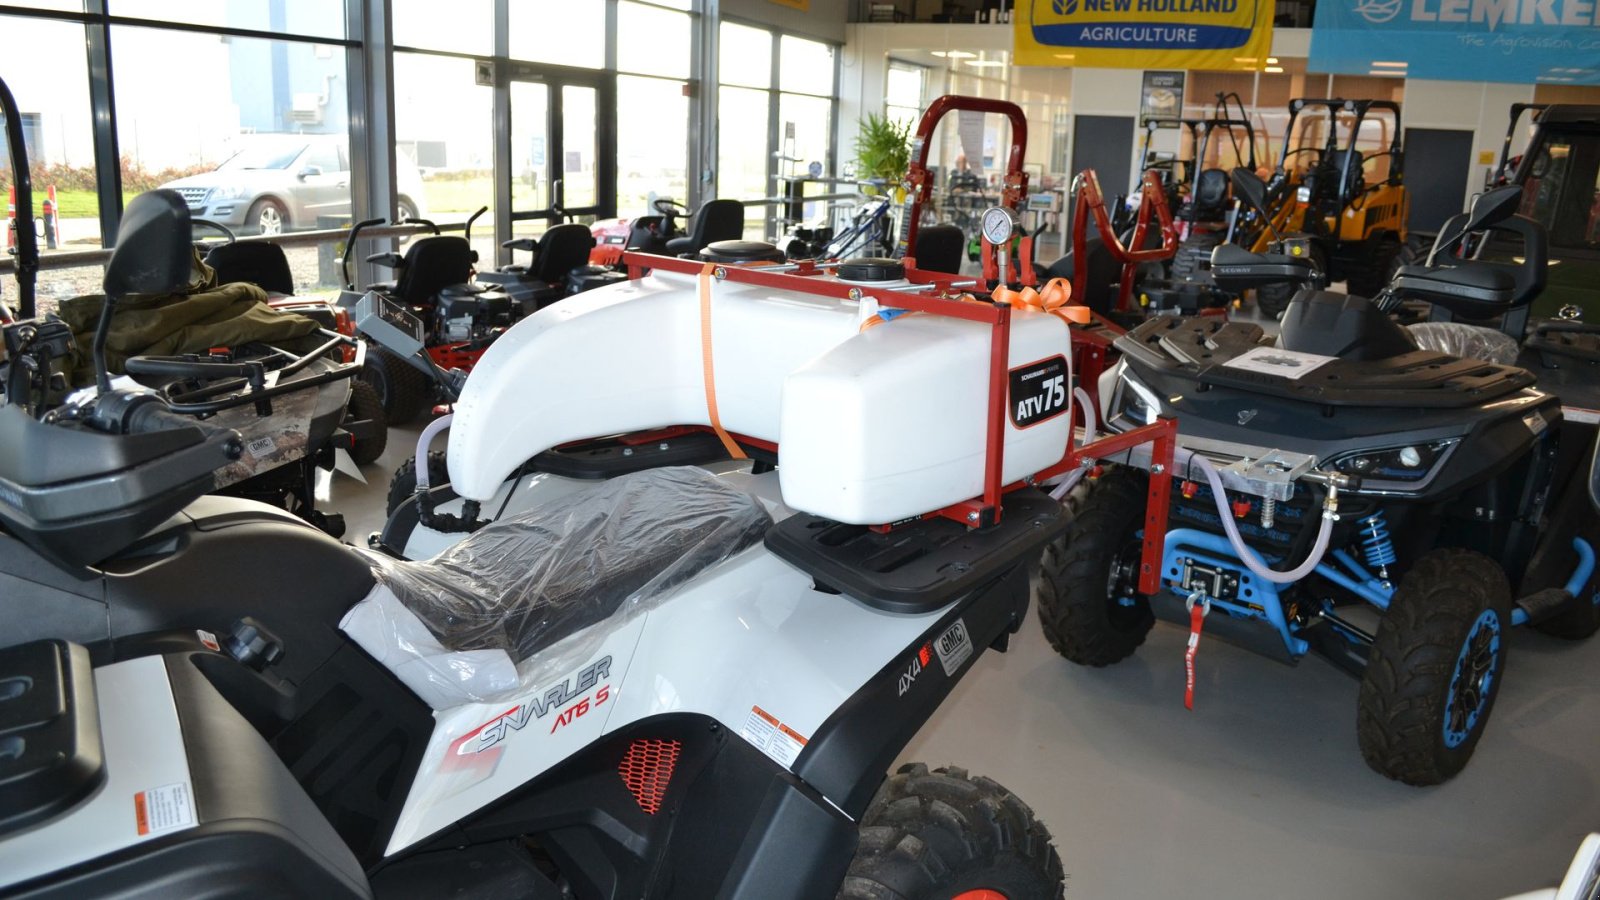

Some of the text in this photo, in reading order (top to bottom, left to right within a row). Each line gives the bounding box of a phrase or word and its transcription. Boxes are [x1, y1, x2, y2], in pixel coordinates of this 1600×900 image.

[1084, 0, 1237, 13] NEW HOLLAND
[1410, 0, 1600, 32] LEMKE
[1080, 27, 1197, 43] AGRICULTURE
[1457, 34, 1485, 47] The
[1491, 35, 1573, 55] Agrovision
[1017, 374, 1065, 420] ATV 75
[941, 625, 962, 653] GMC
[477, 655, 612, 753] SNARLER
[551, 684, 610, 735] AT6 S
